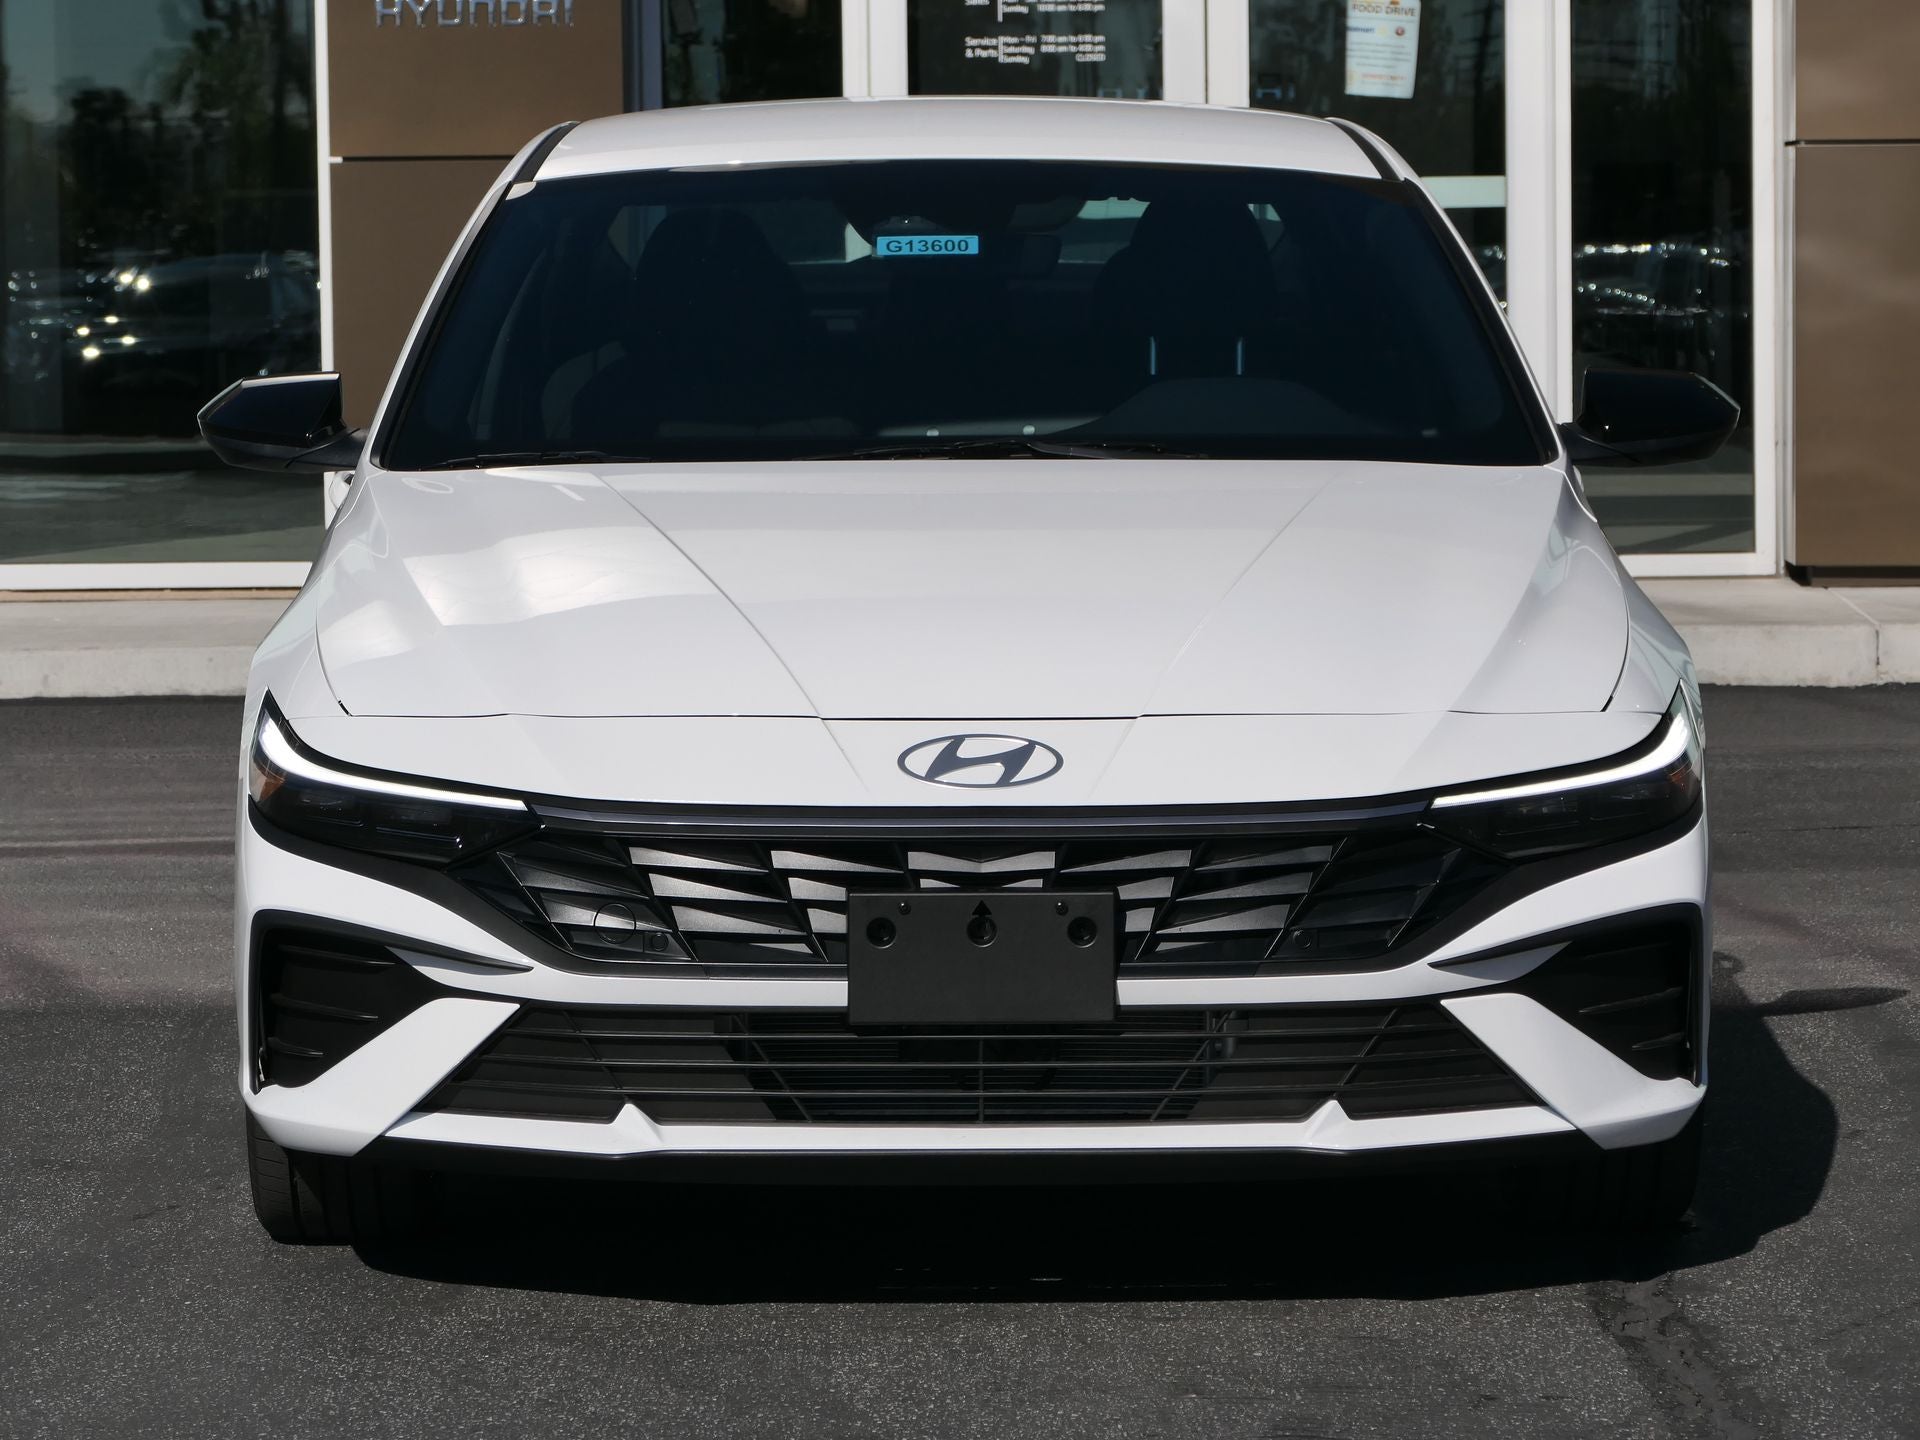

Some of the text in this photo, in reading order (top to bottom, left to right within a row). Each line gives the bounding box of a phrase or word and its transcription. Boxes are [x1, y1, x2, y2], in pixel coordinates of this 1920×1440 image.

[375, 0, 574, 27] HYUNDAI
[1003, 4, 1029, 14] Sunday
[1352, 4, 1417, 17] FOOD DRIVE
[965, 36, 998, 46] Service
[1025, 35, 1037, 43] Fri
[965, 48, 998, 58] & Parts
[1003, 45, 1035, 55] Saturday
[1003, 53, 1106, 64] Sunday CLOSED
[886, 240, 969, 253] G13600
